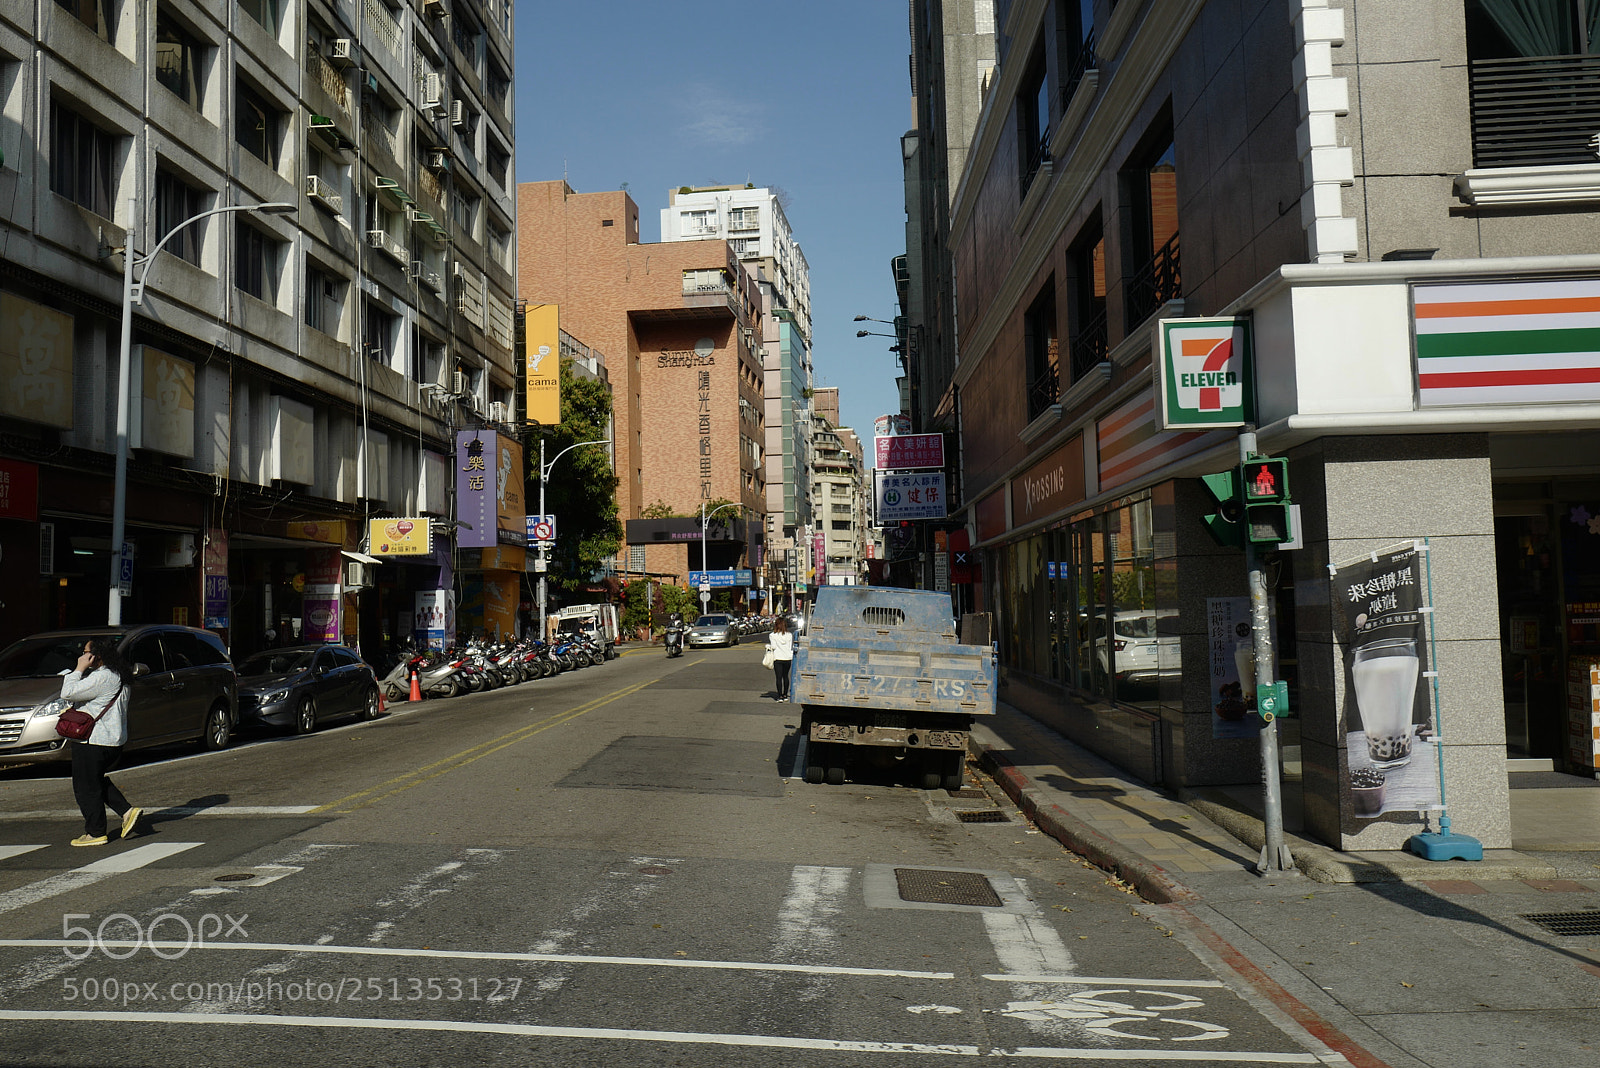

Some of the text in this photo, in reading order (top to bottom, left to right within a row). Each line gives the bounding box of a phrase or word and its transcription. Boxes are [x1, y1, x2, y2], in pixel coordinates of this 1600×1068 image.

[661, 348, 696, 361] Sunny
[528, 378, 557, 386] cama
[1181, 337, 1234, 410] 7
[698, 370, 711, 499] 晴光香格里拉
[462, 438, 485, 491] 樂活
[908, 487, 939, 504] 健保
[207, 577, 227, 599] 刻印
